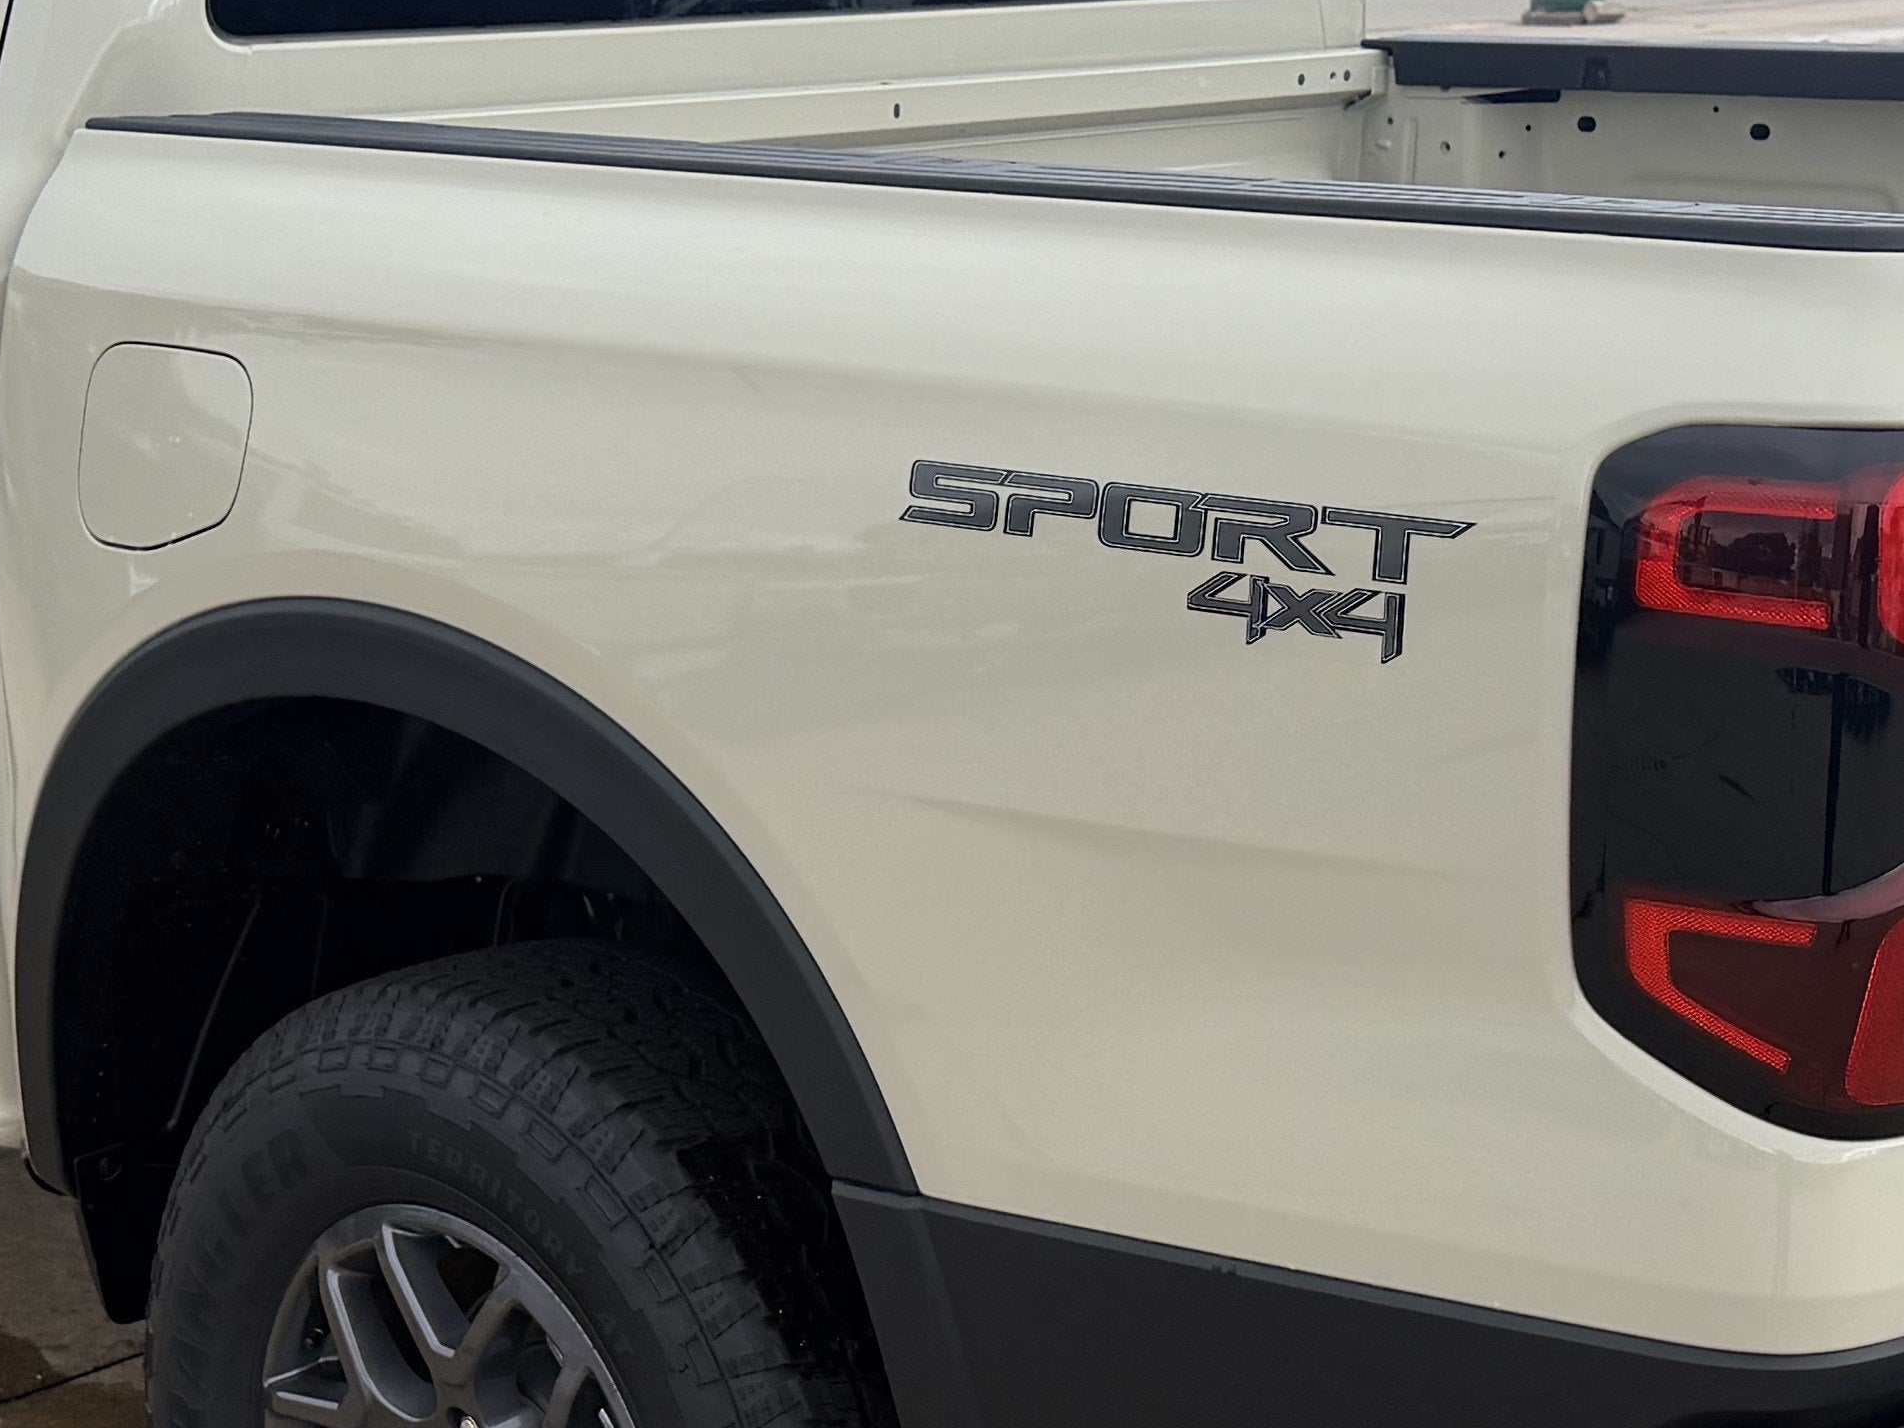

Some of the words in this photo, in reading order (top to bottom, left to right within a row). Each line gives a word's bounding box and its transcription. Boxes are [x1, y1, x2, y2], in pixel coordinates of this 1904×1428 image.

[899, 460, 1477, 584] SPORT
[1187, 570, 1405, 663] 4x4
[406, 1127, 586, 1278] TERRITORY
